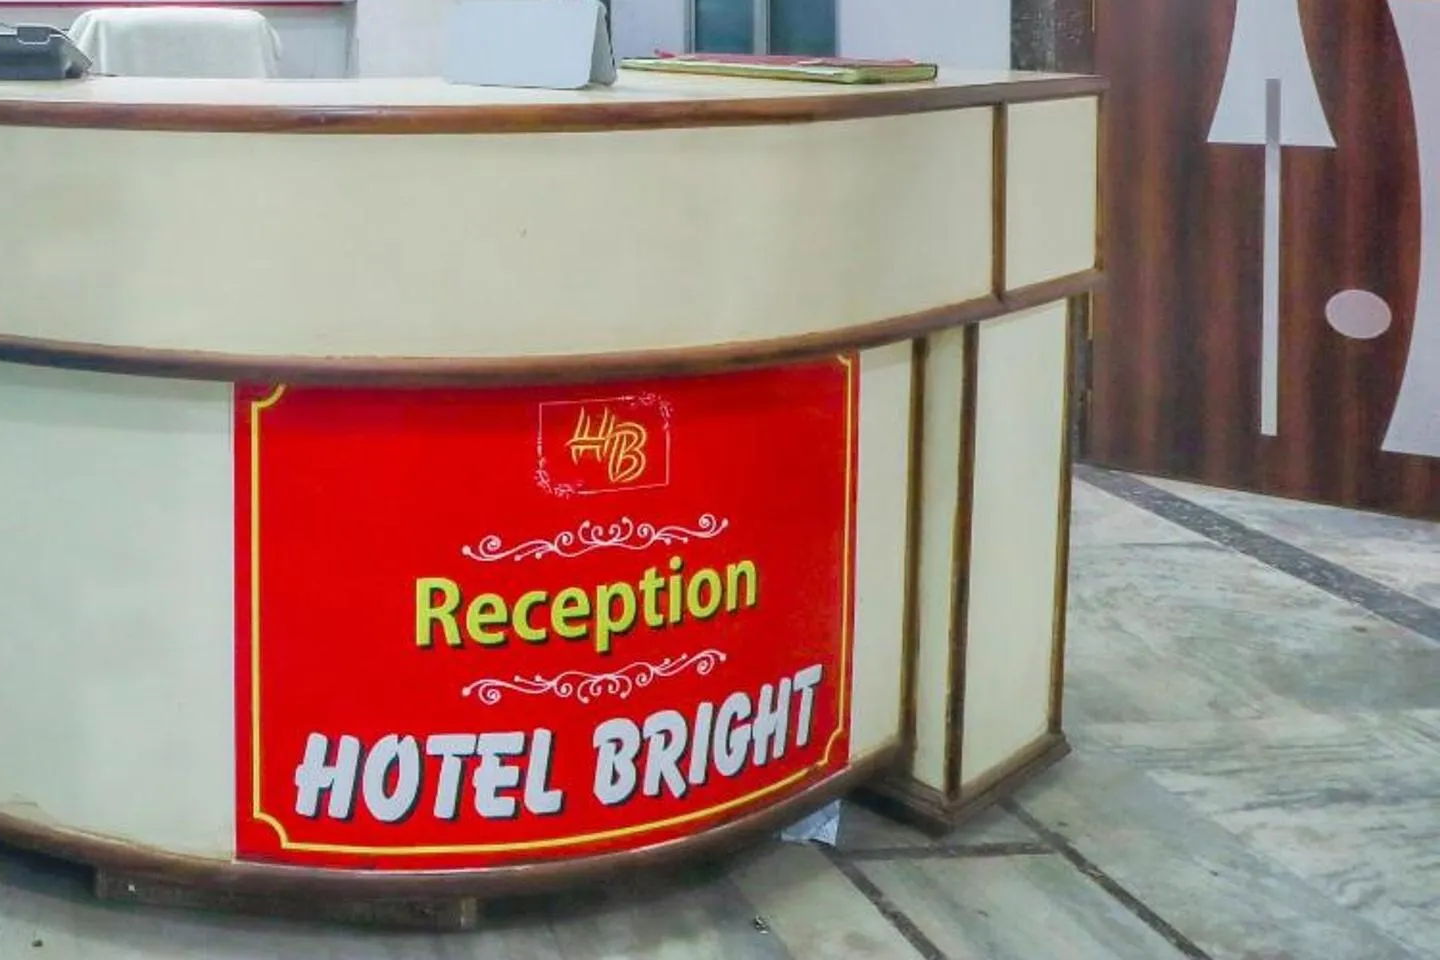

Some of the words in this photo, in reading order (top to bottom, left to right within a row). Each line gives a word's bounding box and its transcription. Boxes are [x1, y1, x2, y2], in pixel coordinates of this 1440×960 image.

[415, 556, 758, 652] Reception
[295, 728, 563, 823] HOTEL
[592, 664, 823, 805] BRIGHT
